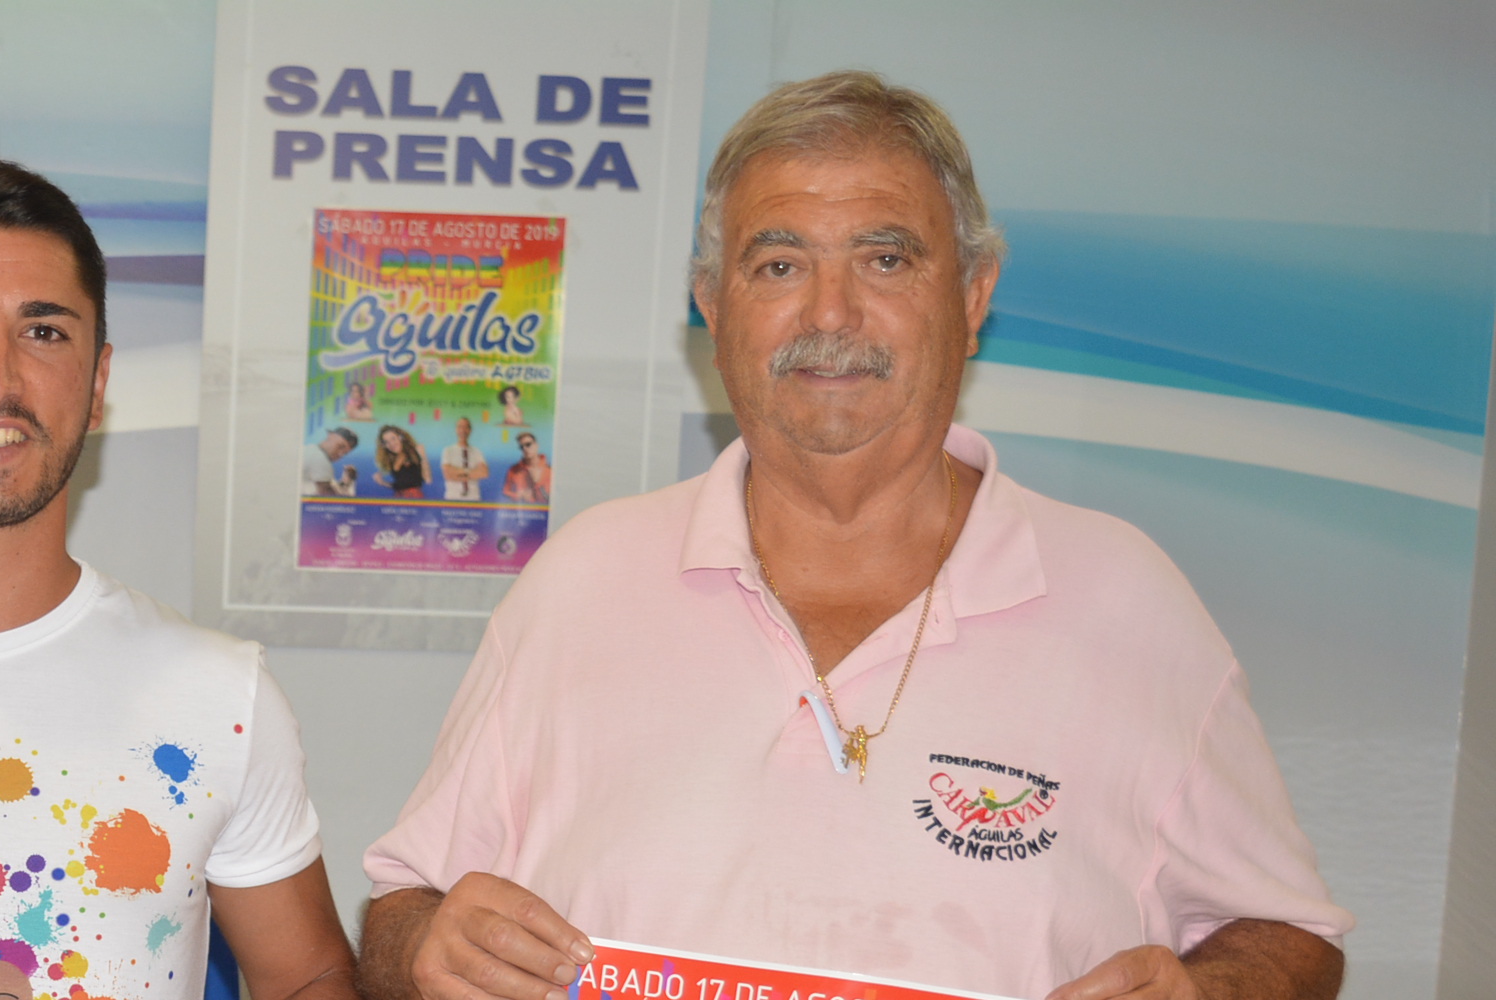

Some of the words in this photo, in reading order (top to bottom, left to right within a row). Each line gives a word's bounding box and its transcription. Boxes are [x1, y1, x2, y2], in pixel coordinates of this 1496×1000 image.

[264, 65, 503, 122] SALA
[535, 75, 652, 127] DE
[272, 130, 640, 191] PRENSA
[929, 753, 1006, 774] FEDERACION
[1008, 766, 1024, 778] DE
[1026, 773, 1060, 791] PEÑAS
[912, 799, 1058, 862] INTERNACIONAL
[577, 954, 684, 1000] ÁBADO
